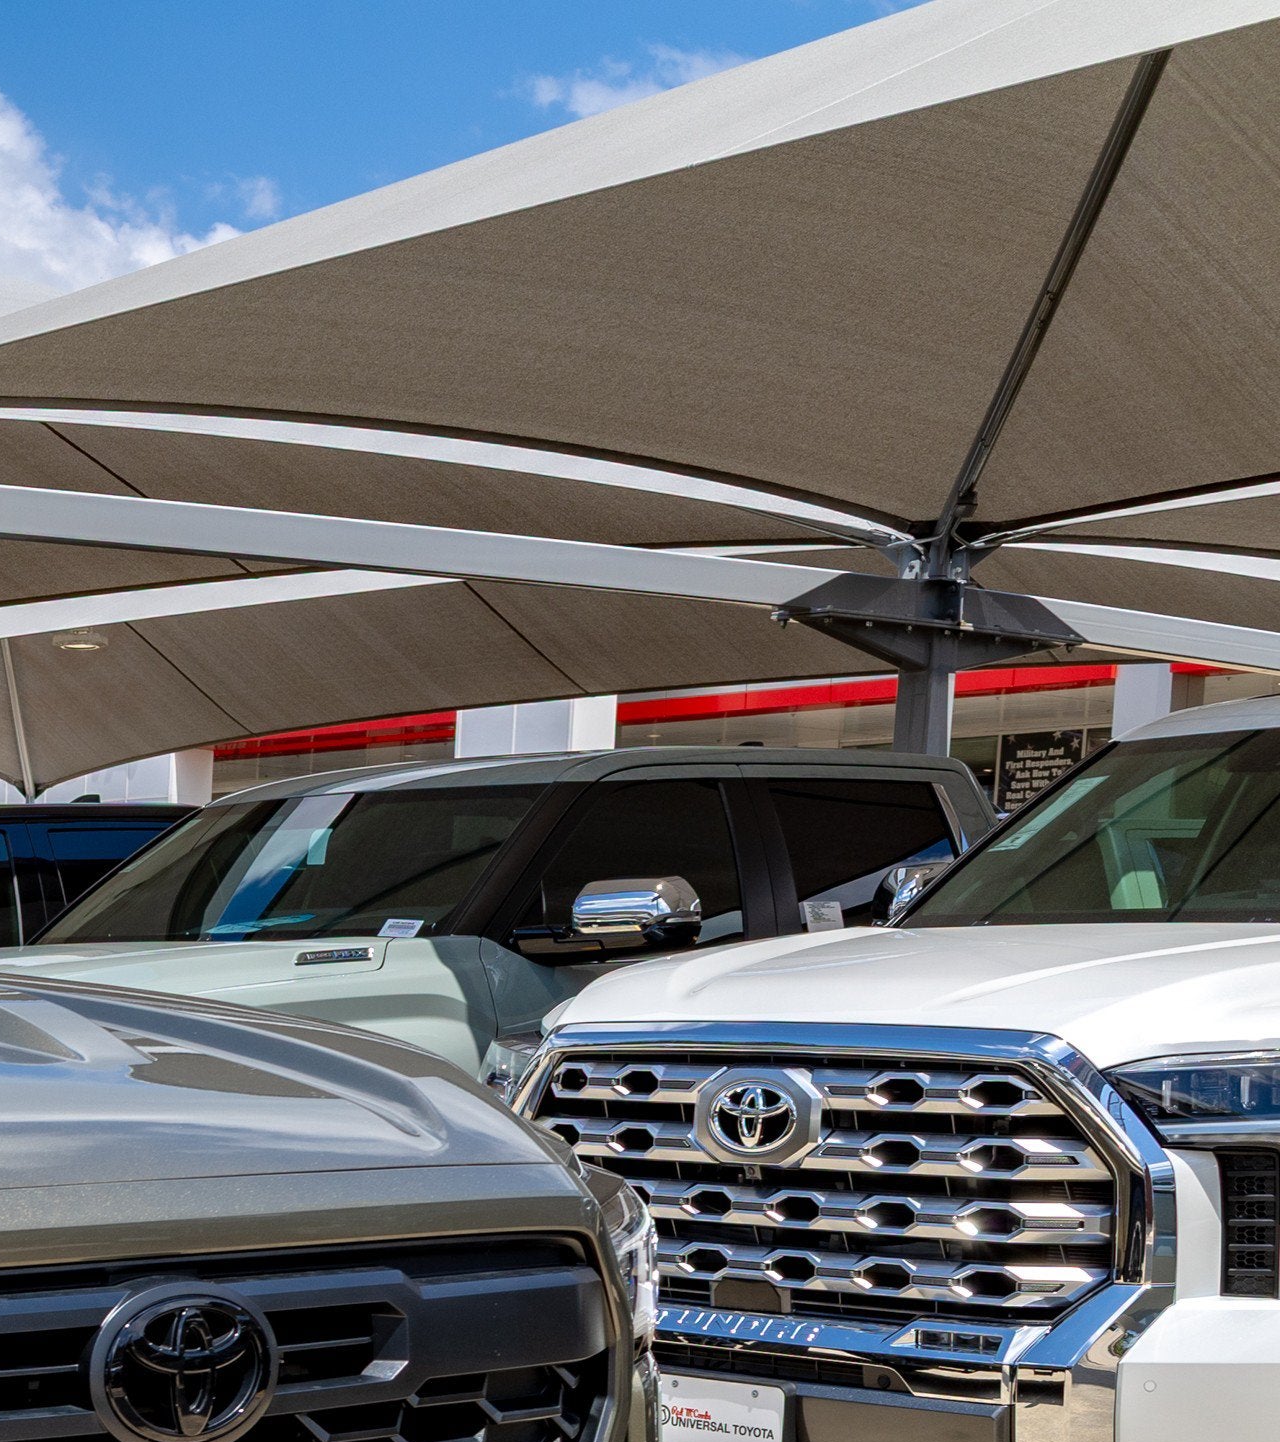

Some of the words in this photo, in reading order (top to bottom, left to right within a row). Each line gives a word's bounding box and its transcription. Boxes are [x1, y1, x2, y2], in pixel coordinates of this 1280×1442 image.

[1016, 748, 1047, 759] Military
[1048, 746, 1064, 756] And
[1005, 760, 1024, 770] First
[1025, 757, 1074, 769] Responders,
[1015, 769, 1031, 779] Ask
[1032, 768, 1050, 778] How
[1010, 780, 1031, 790] Save
[1005, 790, 1024, 800] Real
[671, 1415, 731, 1434] UNIVERSAL
[732, 1424, 775, 1440] TOYOTA
